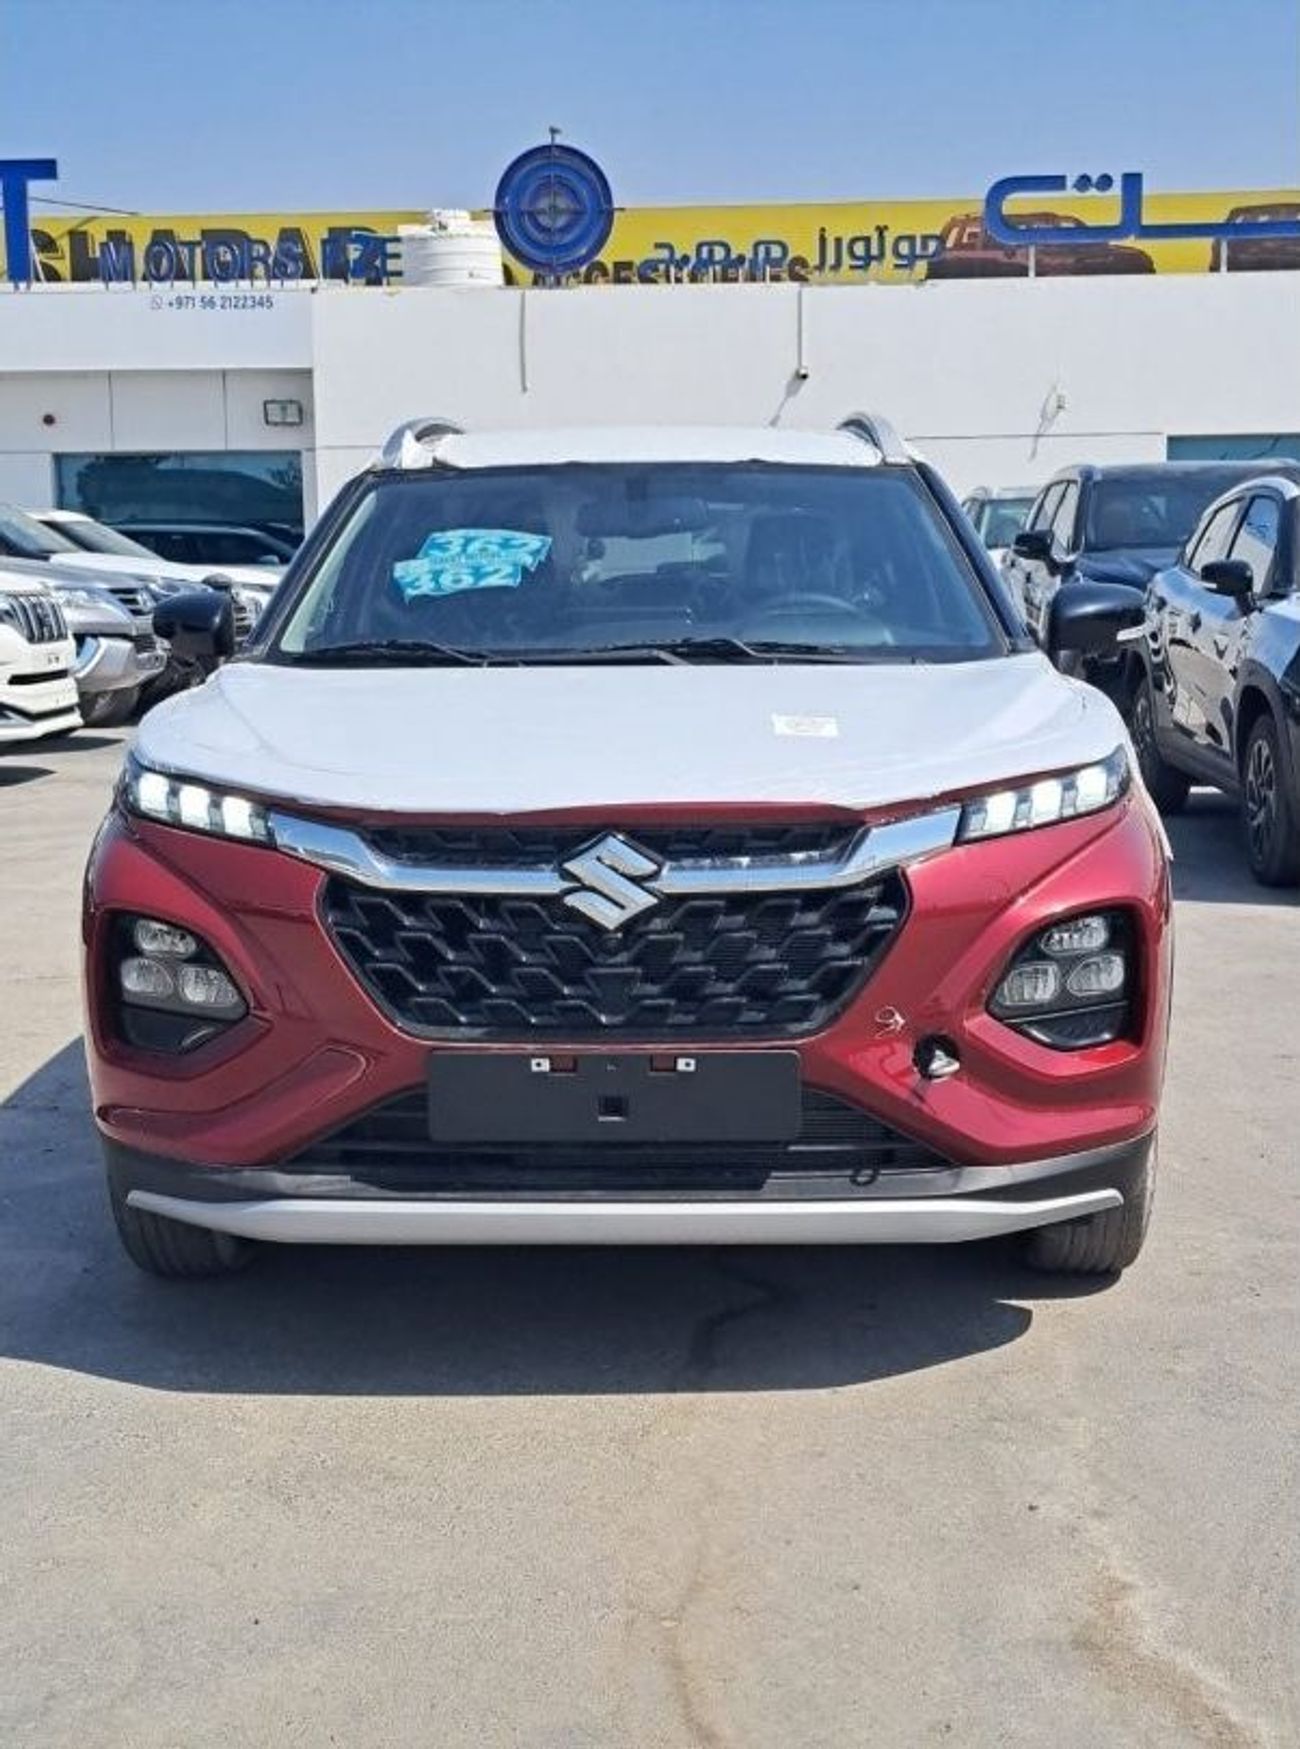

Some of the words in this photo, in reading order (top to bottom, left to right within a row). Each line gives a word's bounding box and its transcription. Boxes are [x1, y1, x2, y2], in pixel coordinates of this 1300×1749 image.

[100, 237, 303, 283] MOTORS
[168, 295, 196, 310] +971
[200, 295, 217, 310] 56
[220, 295, 274, 310] 2122345
